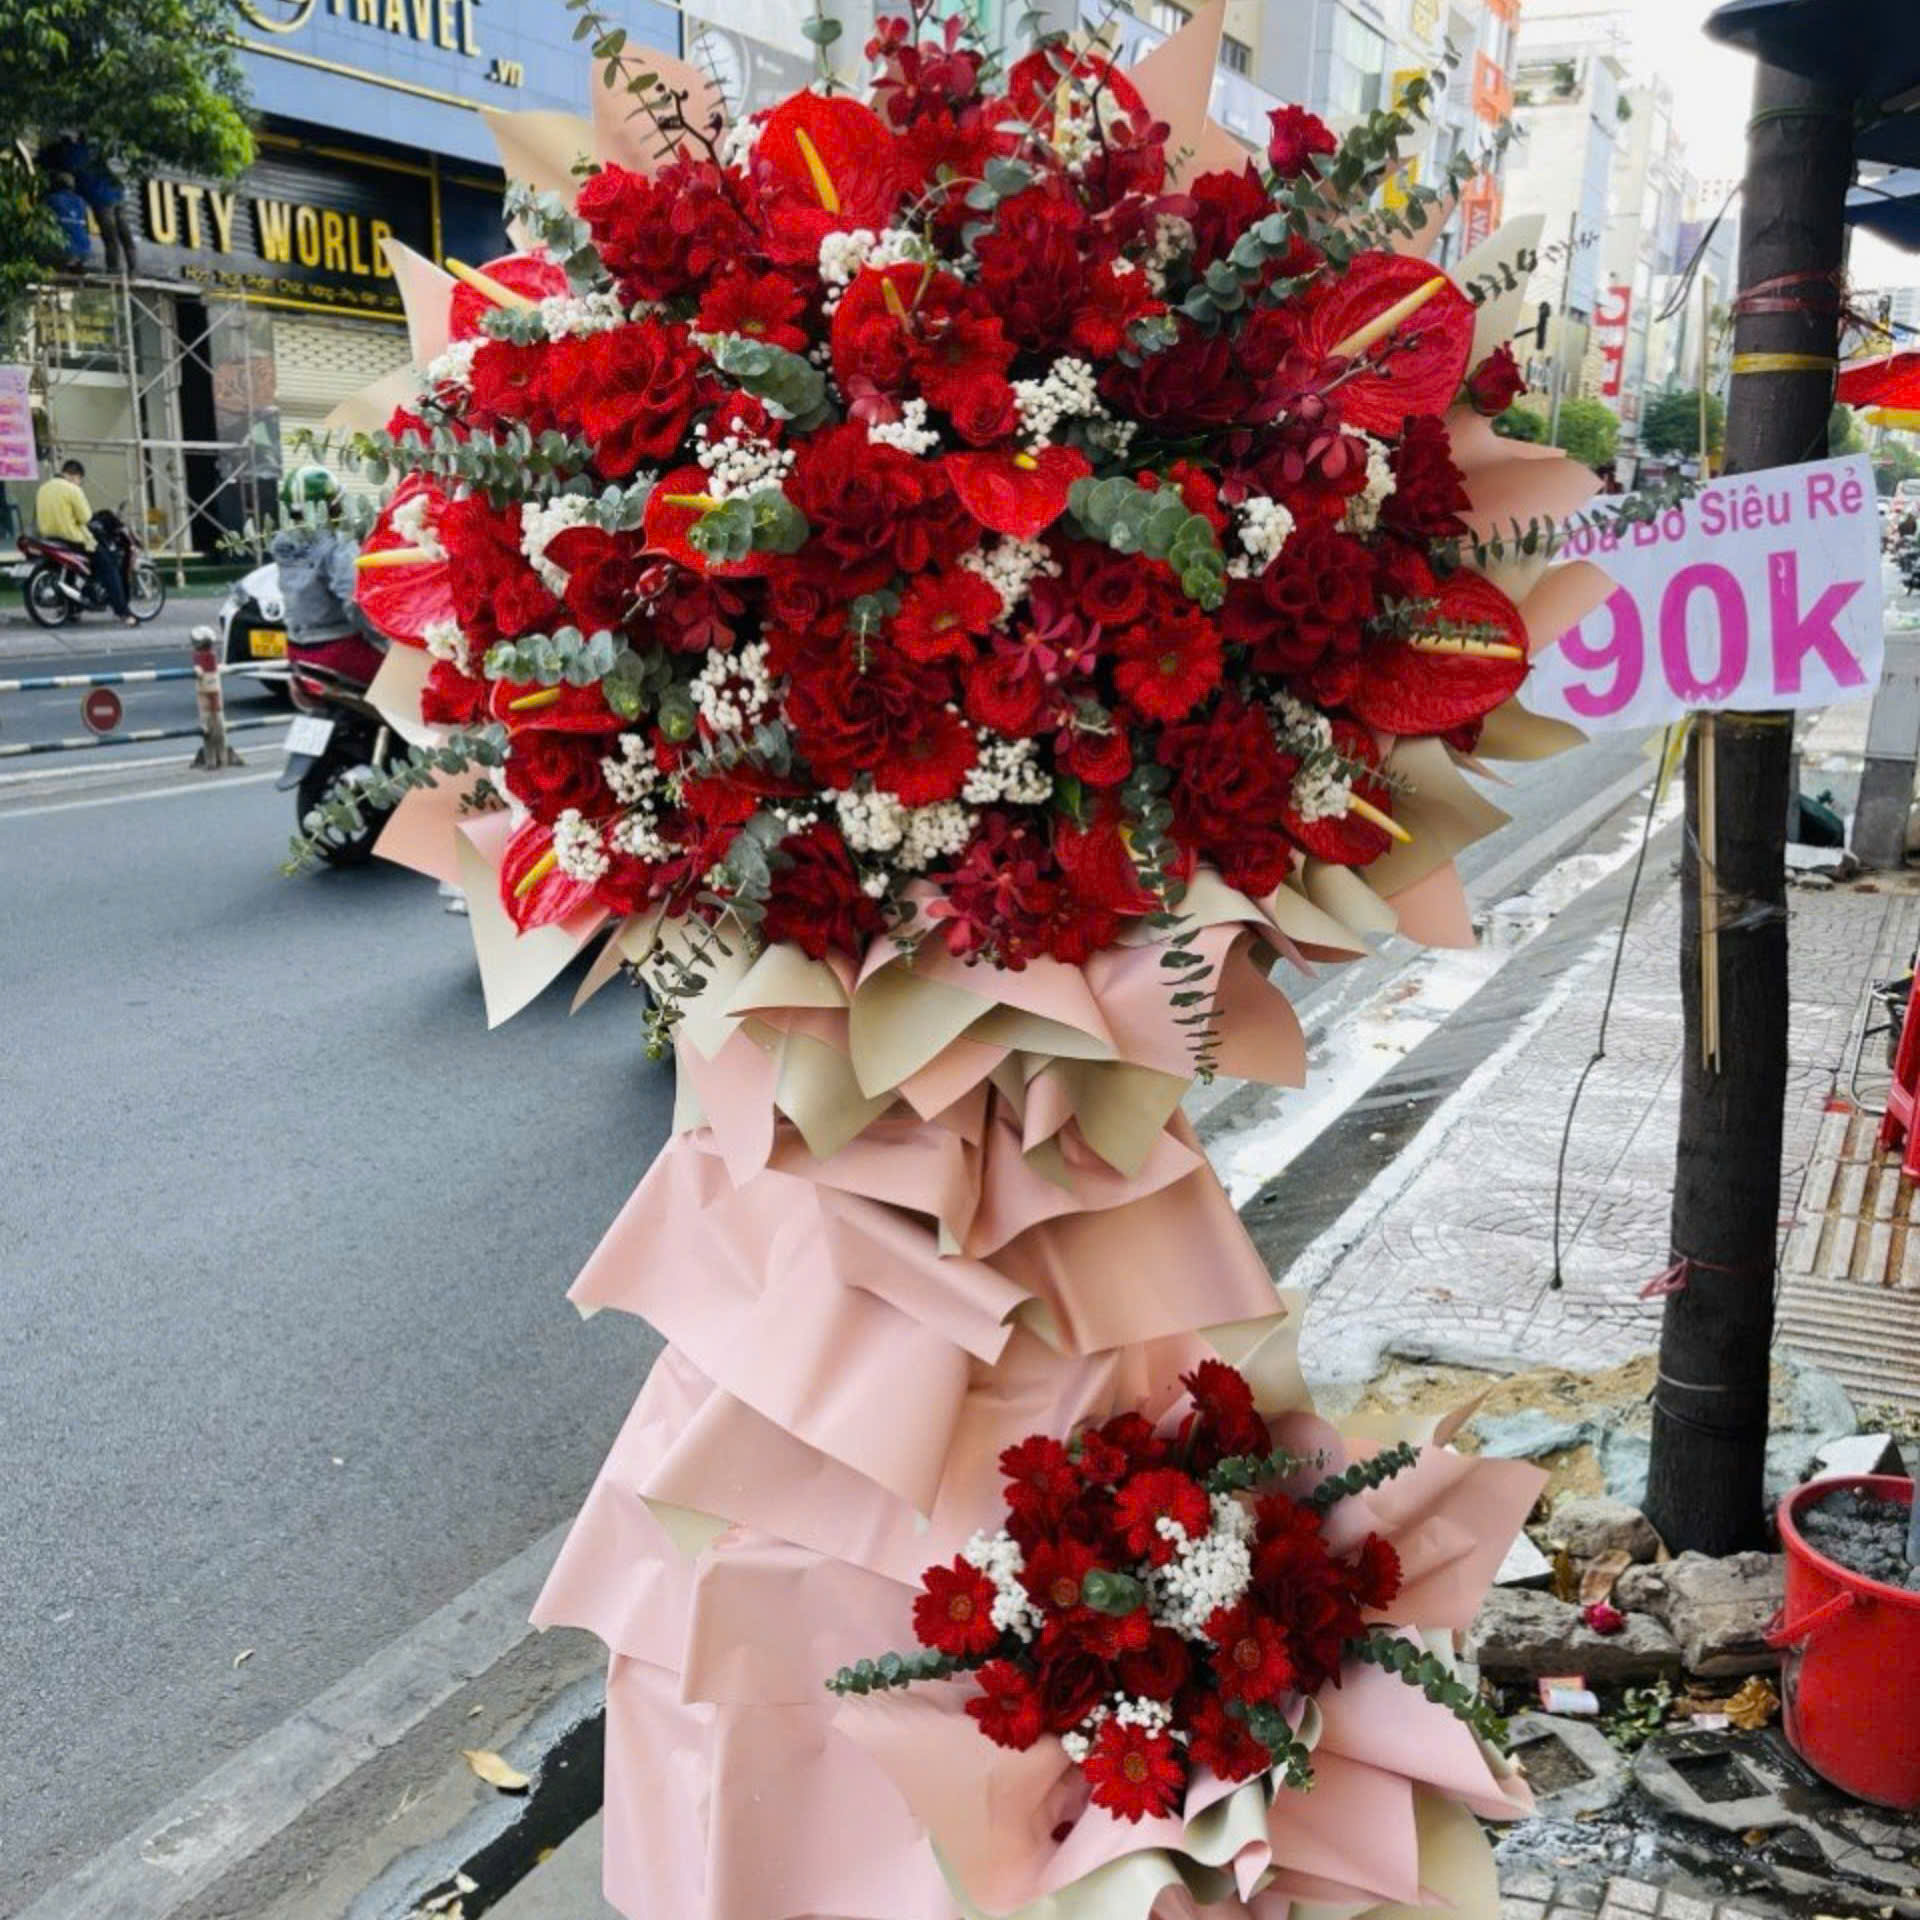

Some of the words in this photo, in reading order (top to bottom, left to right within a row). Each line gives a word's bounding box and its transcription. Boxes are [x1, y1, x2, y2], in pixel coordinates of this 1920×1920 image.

[331, 0, 480, 56] AVEL
[257, 199, 394, 278] WORLD
[1562, 516, 1619, 558] oa
[1701, 485, 1791, 537] Siêu
[1807, 467, 1863, 520] Rẻ
[1558, 550, 1868, 718] 90k
